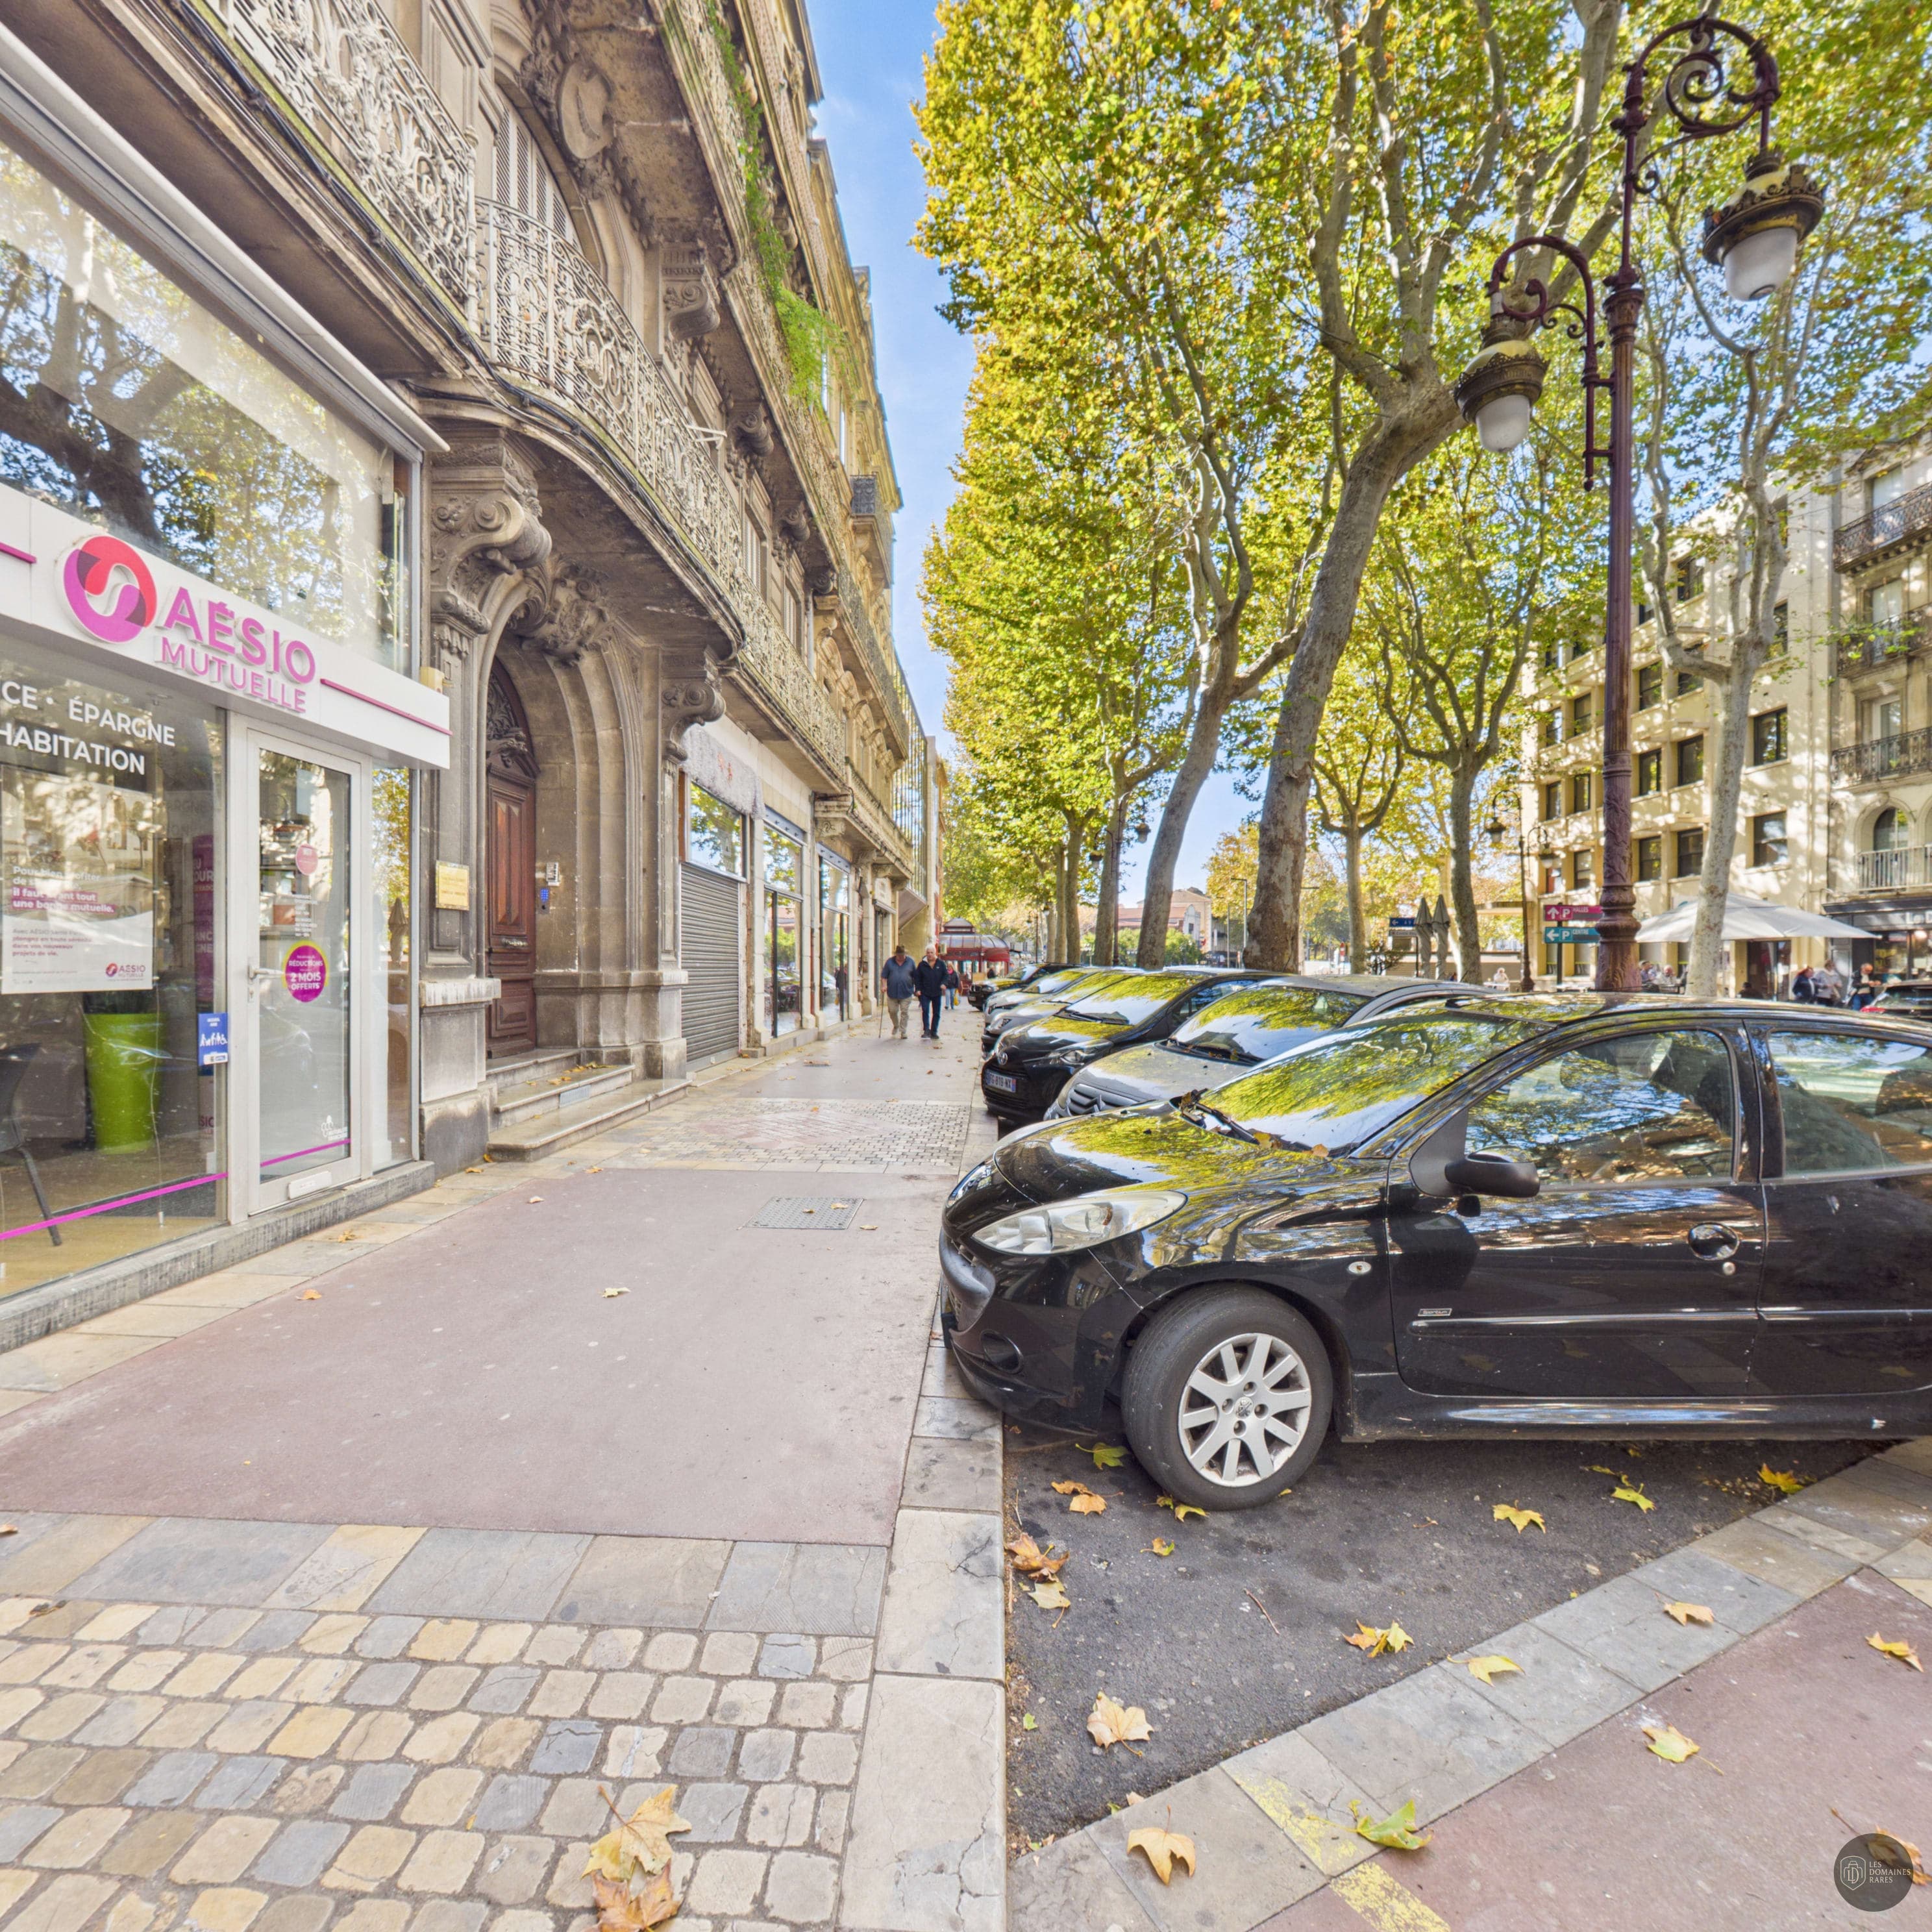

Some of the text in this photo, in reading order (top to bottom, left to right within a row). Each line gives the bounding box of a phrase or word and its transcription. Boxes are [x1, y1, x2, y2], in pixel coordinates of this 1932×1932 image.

[161, 586, 316, 684] AÉSIO
[160, 636, 306, 713] MUTUELLE
[68, 695, 176, 747] ÉPARGNE
[12, 900, 34, 909] une
[290, 971, 321, 982] 2 MOIS
[290, 982, 321, 991] OFFERTS
